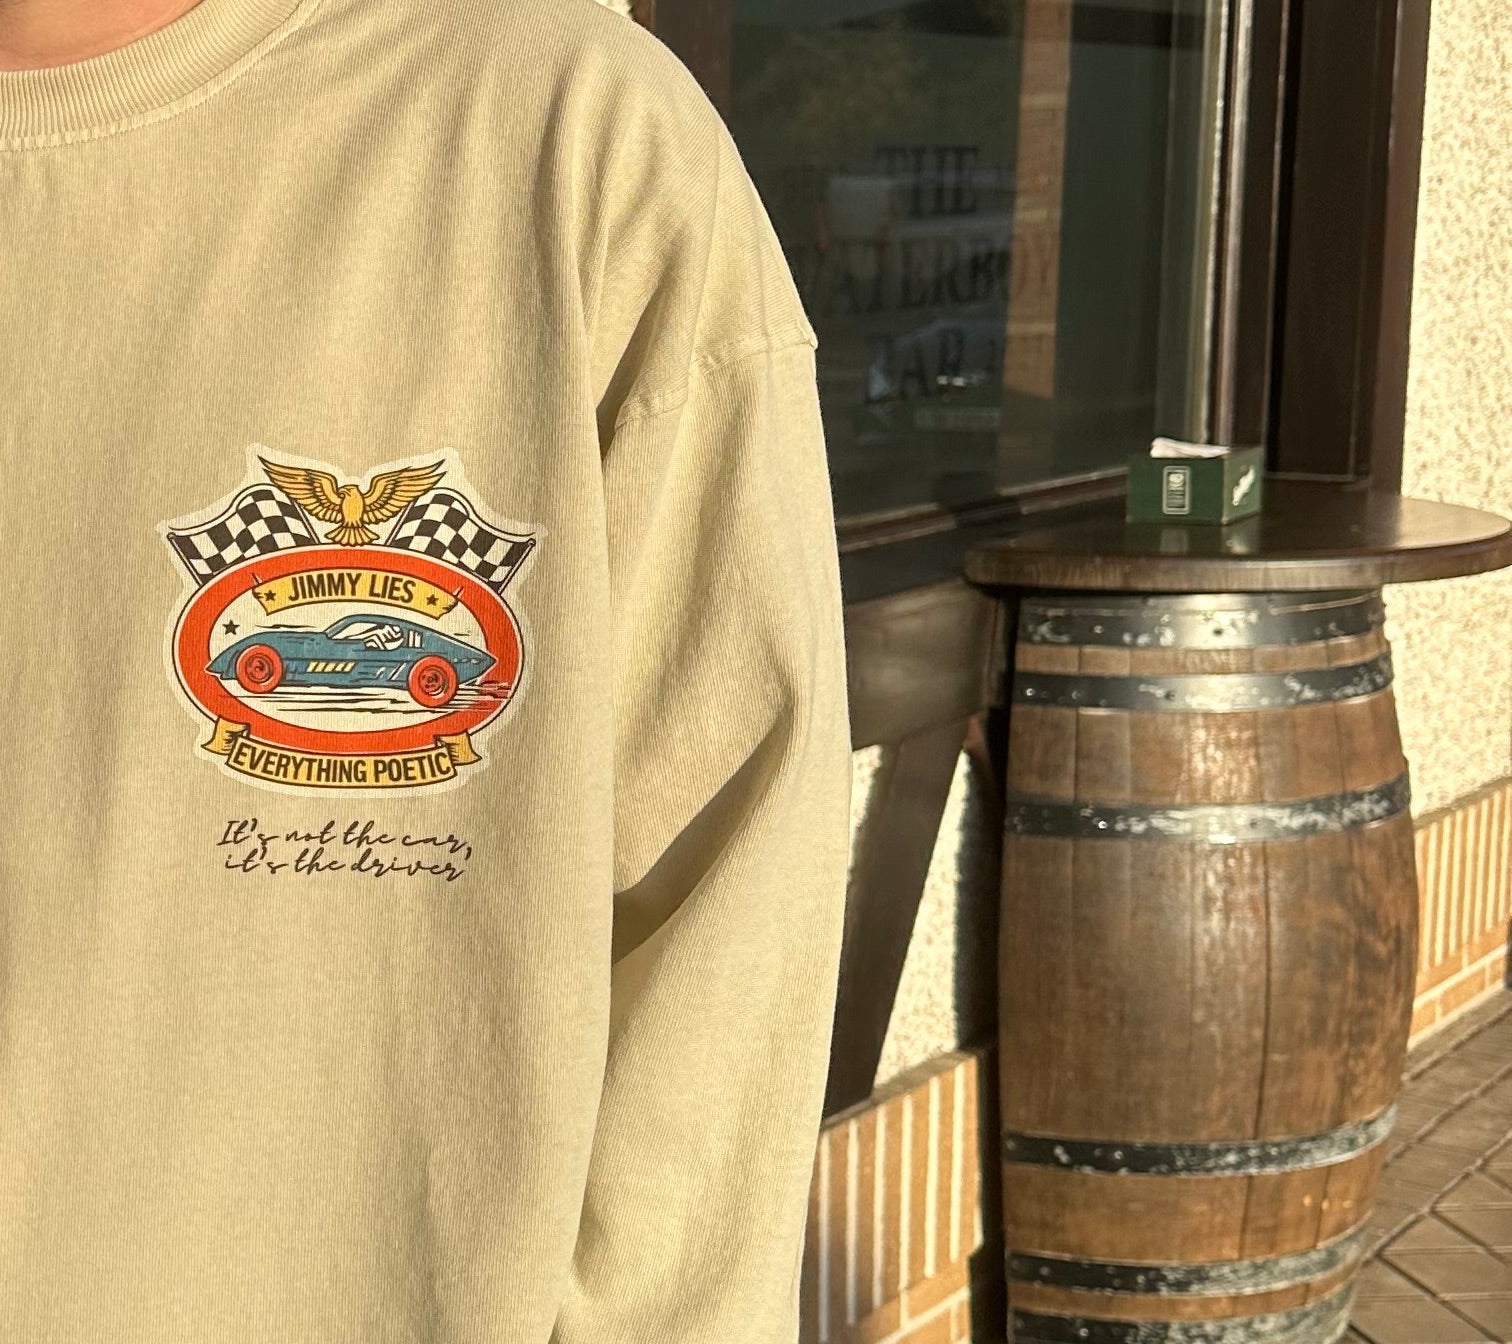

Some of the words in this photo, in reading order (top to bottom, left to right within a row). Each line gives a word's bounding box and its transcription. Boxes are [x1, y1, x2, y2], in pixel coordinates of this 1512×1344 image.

[874, 144, 979, 219] THE
[287, 572, 363, 602] JIMMY
[368, 573, 417, 604] LIES
[232, 741, 367, 783] EVERYTHING
[373, 752, 452, 783] POETIC
[216, 817, 280, 847] It's
[285, 819, 337, 844] not
[343, 819, 397, 848] the
[224, 845, 289, 874] it's
[294, 846, 347, 876] the
[350, 846, 465, 882] driver
